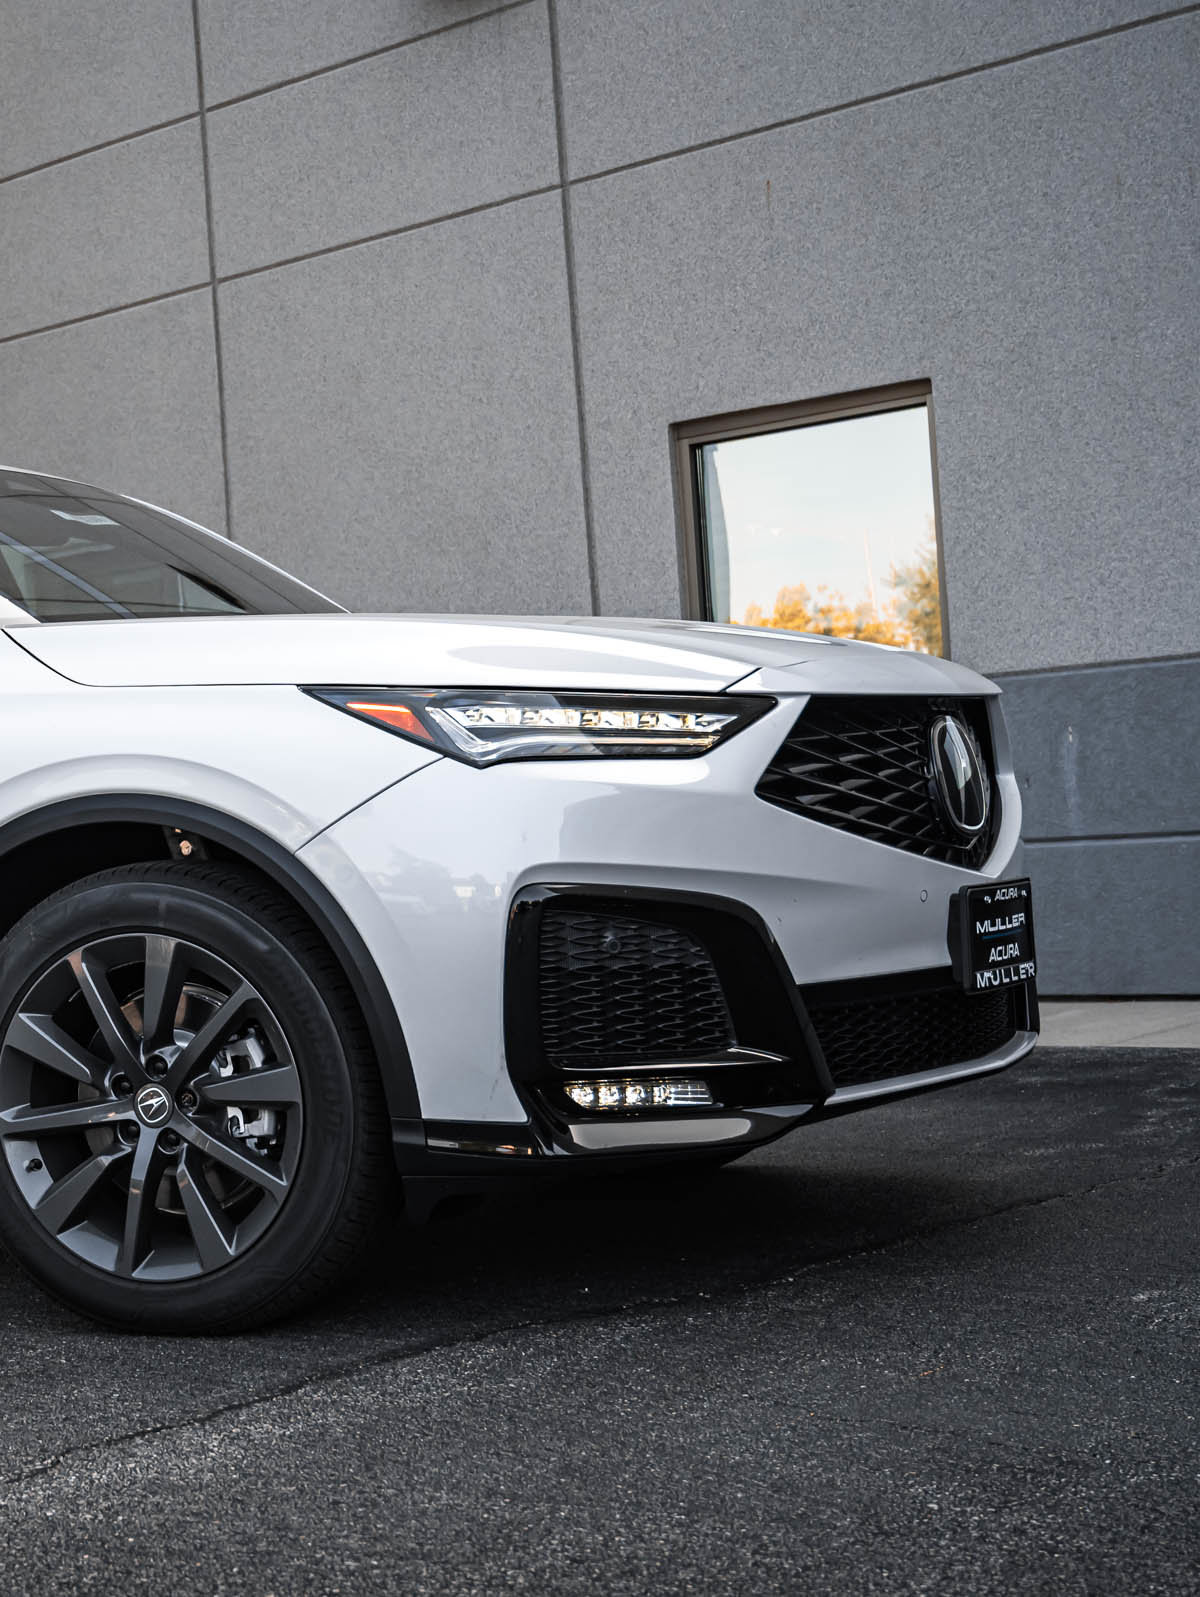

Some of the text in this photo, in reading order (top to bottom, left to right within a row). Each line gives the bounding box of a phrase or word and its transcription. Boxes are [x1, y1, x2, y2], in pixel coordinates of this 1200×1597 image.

[994, 887, 1018, 901] ACURA
[976, 912, 1026, 934] MULLER
[989, 942, 1020, 963] ACURA
[976, 962, 1036, 989] MULLER
